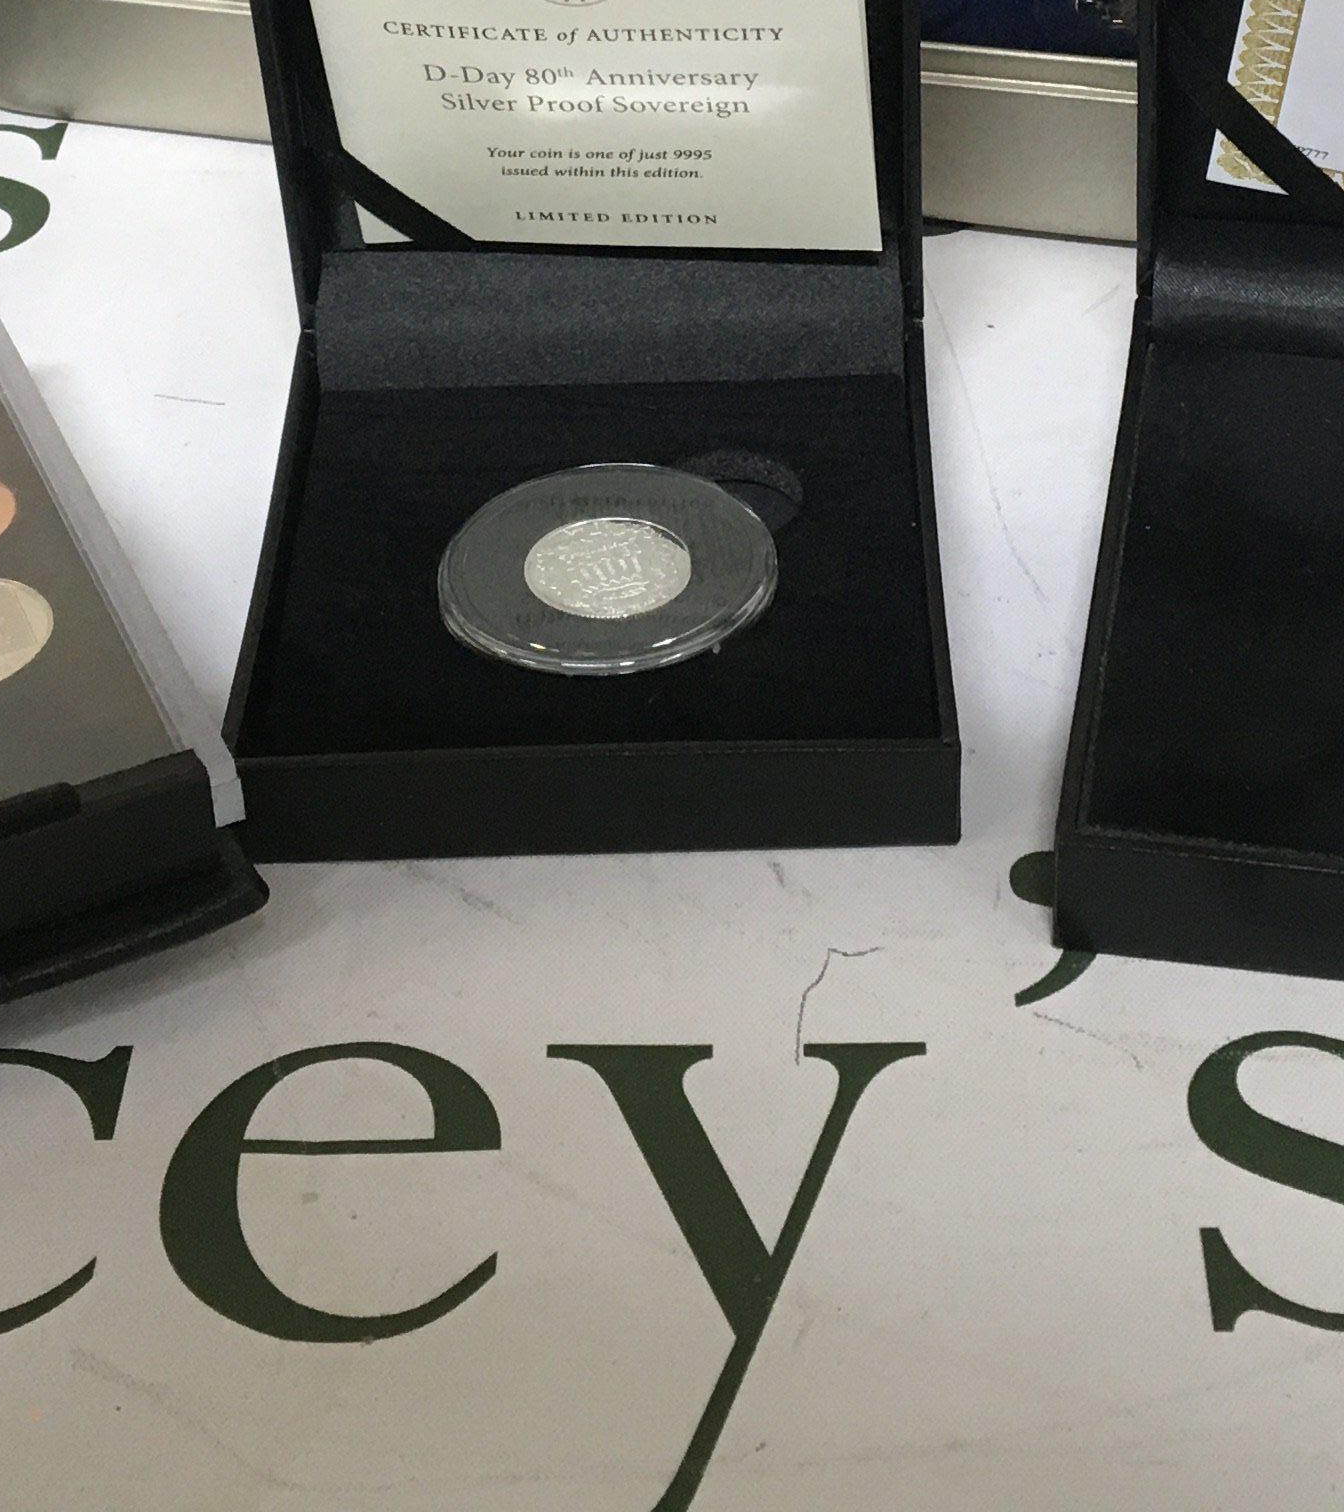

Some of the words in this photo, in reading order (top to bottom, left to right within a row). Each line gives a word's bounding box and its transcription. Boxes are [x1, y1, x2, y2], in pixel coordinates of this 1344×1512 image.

[382, 20, 548, 42] CERTIFICATE
[556, 27, 580, 46] of
[586, 26, 784, 43] AUTHENTICITY
[422, 63, 517, 91] D-Day
[585, 67, 760, 91] Anniversary
[440, 92, 518, 113] Silver
[526, 95, 605, 114] Proof
[611, 95, 751, 120] Sovereign
[486, 146, 526, 159] Your
[529, 147, 564, 160] coin
[568, 148, 581, 160] is
[584, 150, 614, 160] one
[617, 147, 636, 164] of
[636, 148, 668, 164] just
[672, 149, 714, 161] 9995
[500, 165, 550, 177] issued
[553, 165, 606, 178] within
[609, 165, 640, 179] this
[642, 166, 703, 179] edition.
[514, 210, 611, 223] LIMITED
[620, 213, 718, 225] EDITION
